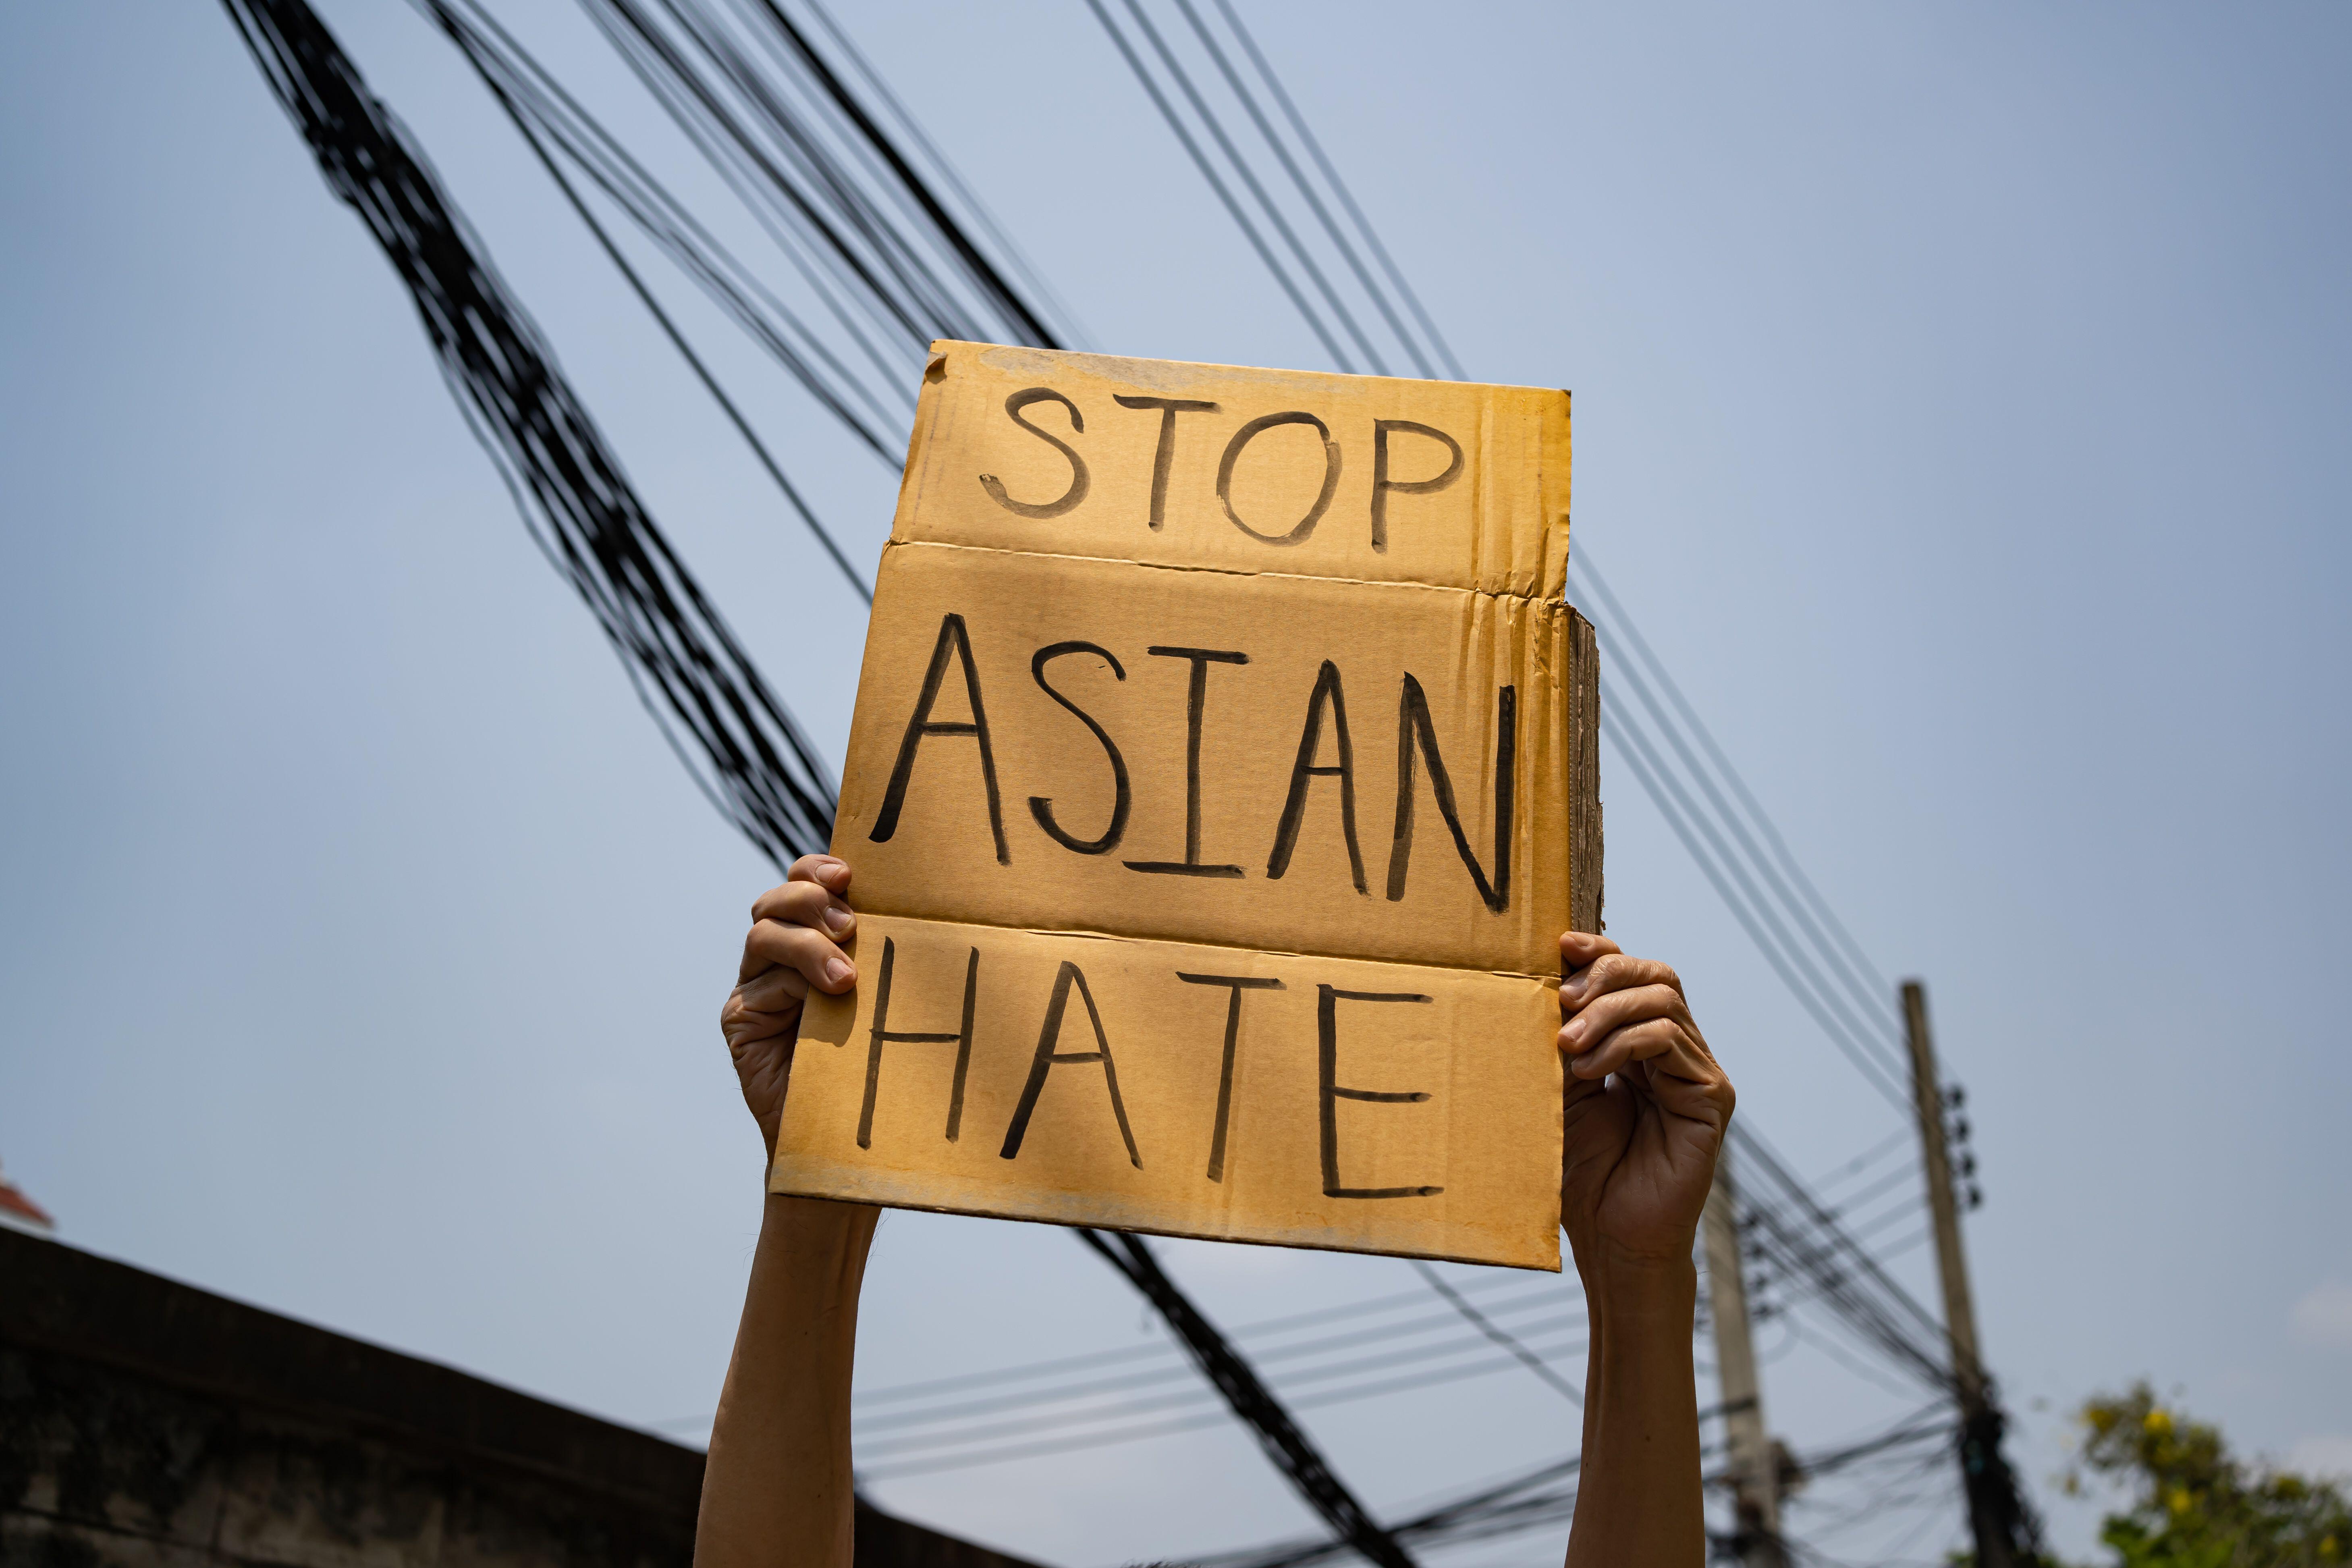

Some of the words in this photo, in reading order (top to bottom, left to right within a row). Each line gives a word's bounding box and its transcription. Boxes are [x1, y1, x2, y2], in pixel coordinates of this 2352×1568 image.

[979, 387, 1465, 553] STOP
[869, 613, 1516, 916] ASIAN
[857, 936, 1444, 1198] HATE
